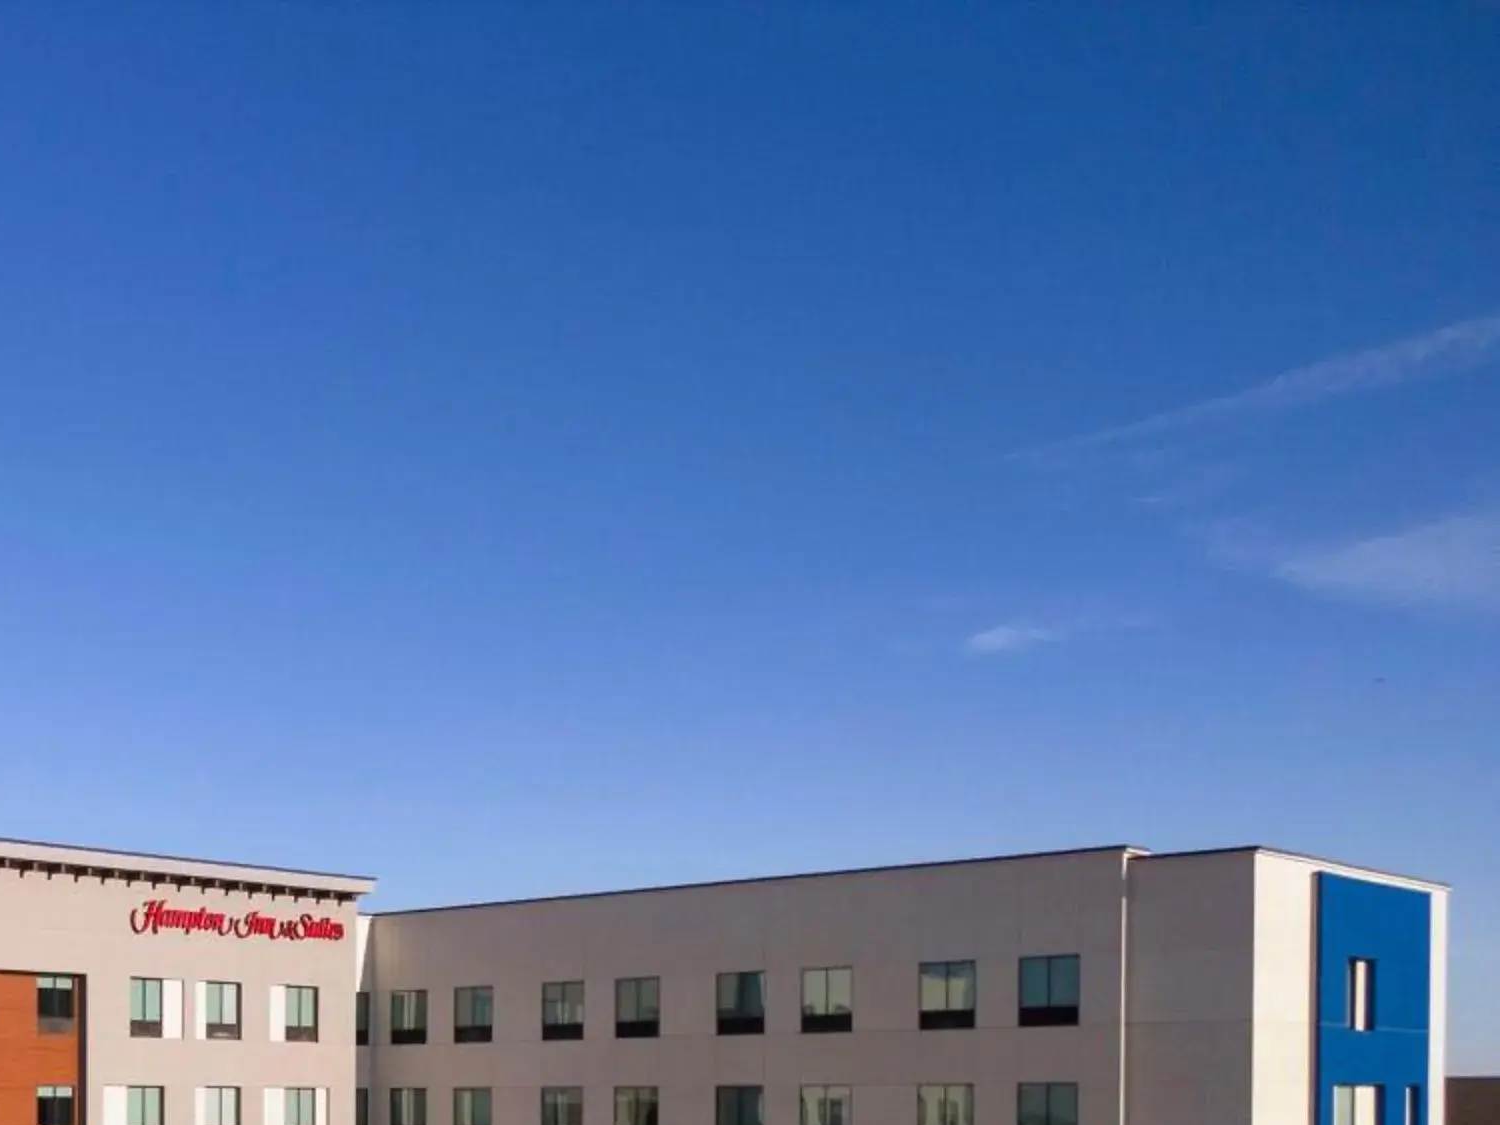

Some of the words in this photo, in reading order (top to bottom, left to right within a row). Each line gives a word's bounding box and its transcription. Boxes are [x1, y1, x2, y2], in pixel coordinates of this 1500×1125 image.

[130, 899, 233, 936] Hampton
[234, 911, 281, 939] Inn
[294, 913, 344, 940] Suites
